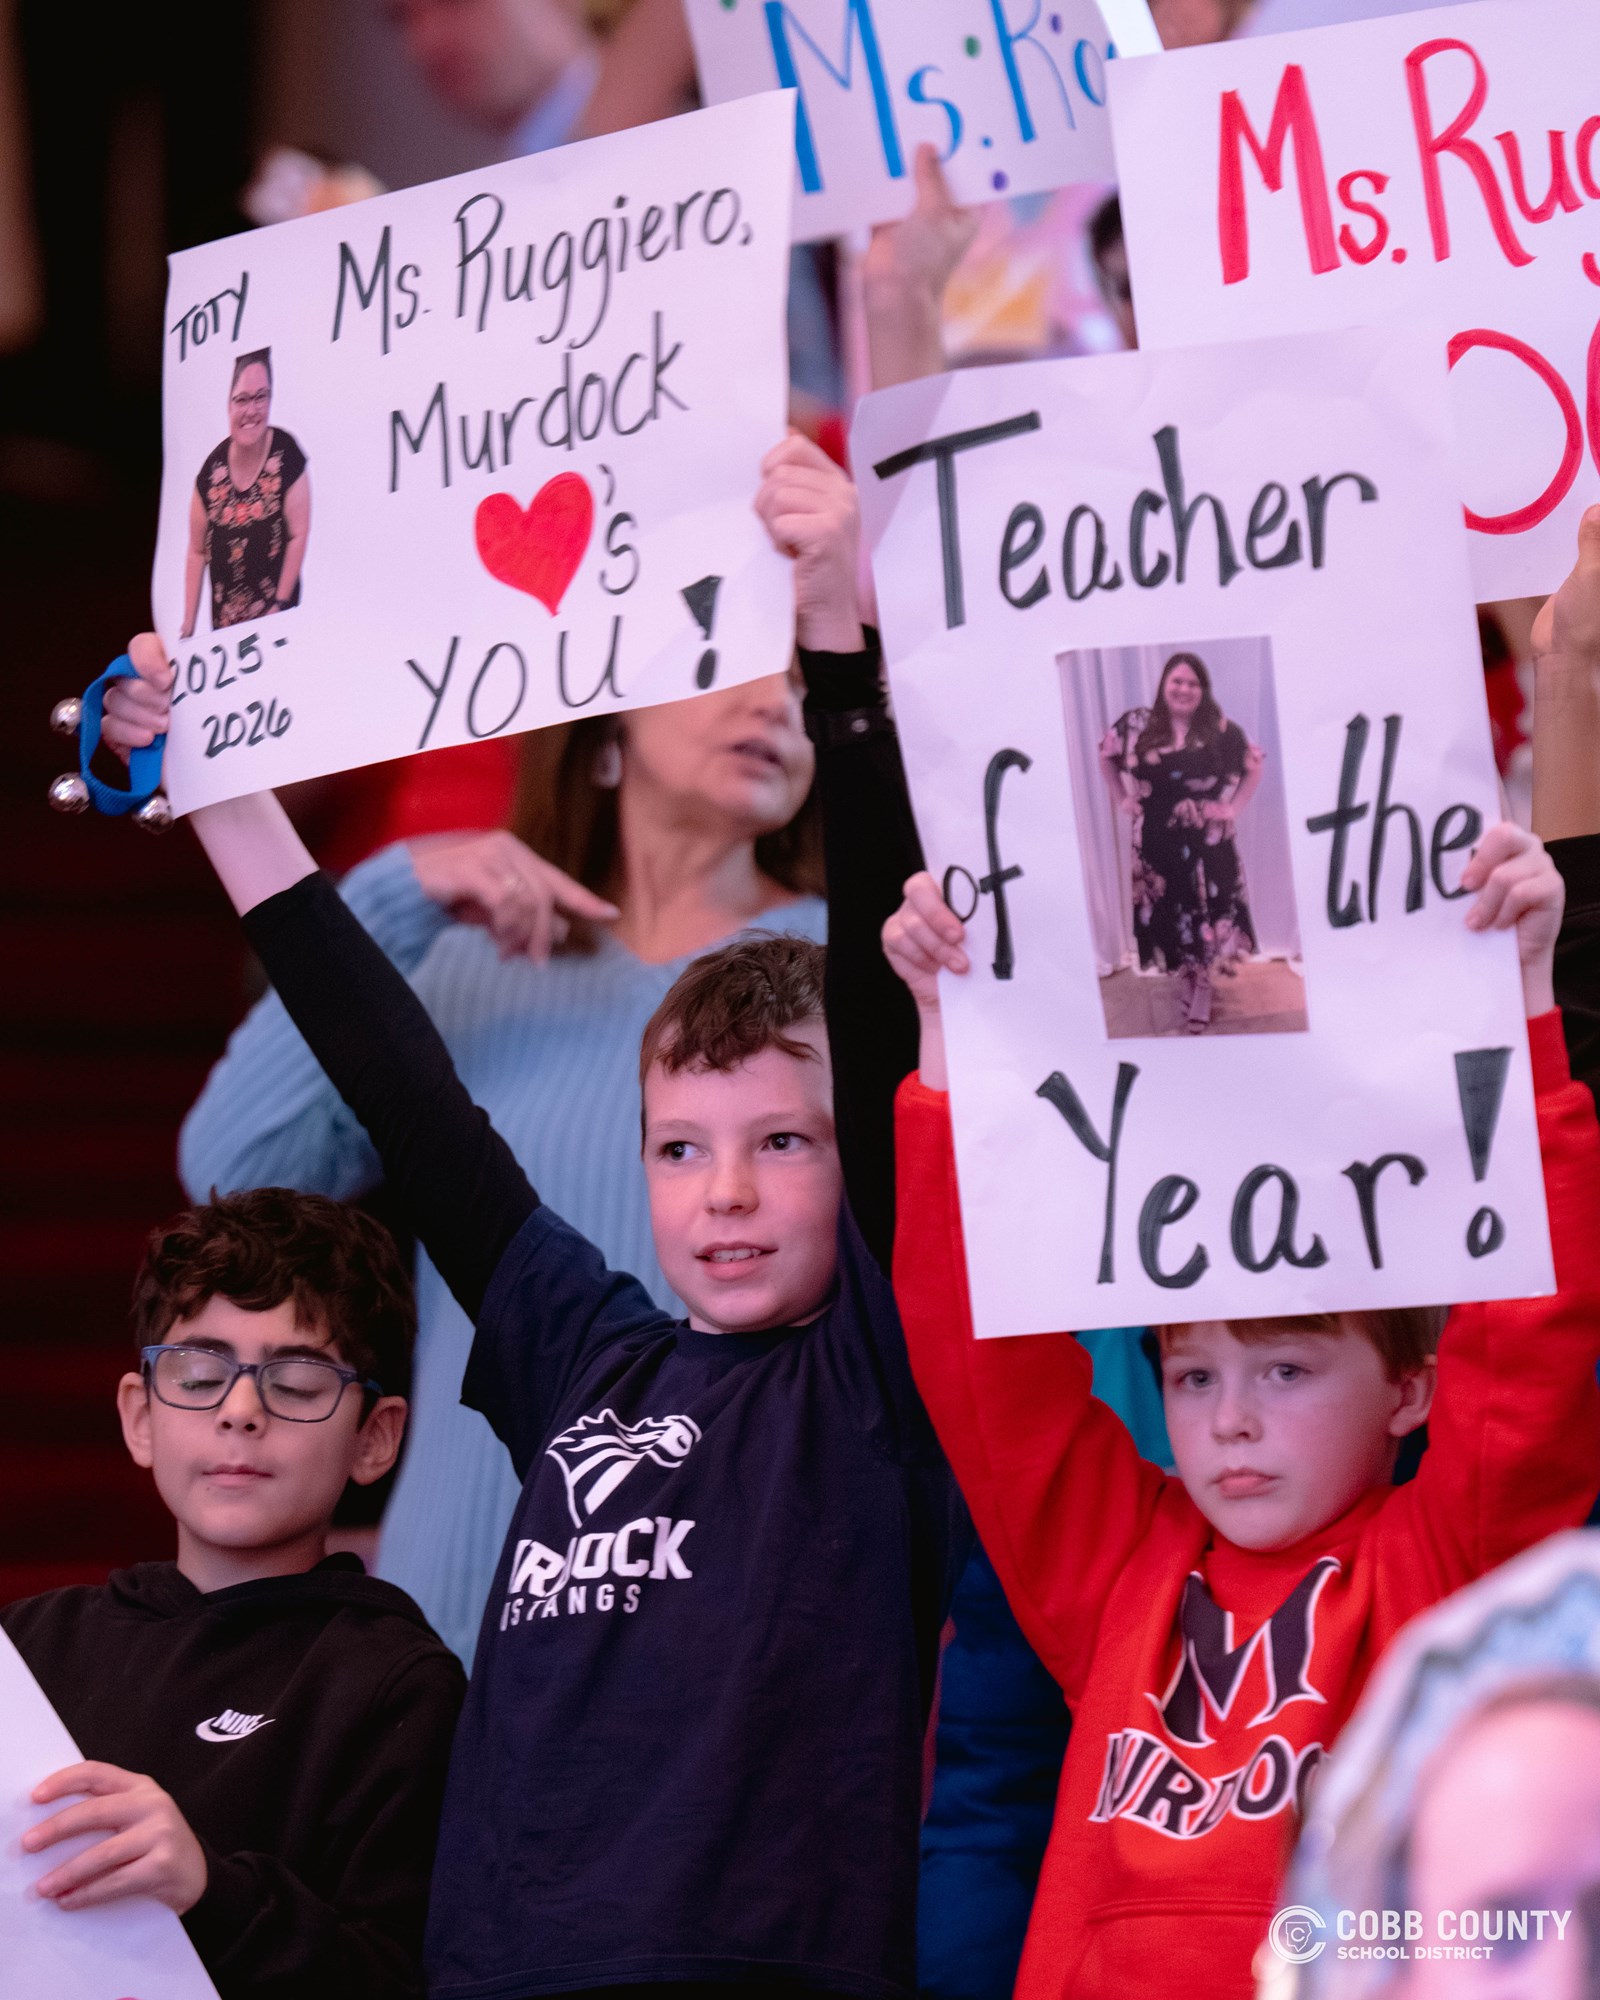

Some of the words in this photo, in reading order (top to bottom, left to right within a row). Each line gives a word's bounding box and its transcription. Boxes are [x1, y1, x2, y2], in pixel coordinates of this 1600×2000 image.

[764, 0, 993, 194] Ms.
[991, 0, 1118, 143] Ro
[1218, 63, 1407, 286] Ms.
[170, 270, 249, 363] TOTY
[331, 226, 432, 354] Ms.
[454, 187, 754, 350] Ruggiero,
[388, 311, 689, 493] Murdock
[873, 410, 1379, 630] Teacher
[202, 697, 292, 759] 2026
[943, 748, 1032, 980] of
[1306, 713, 1482, 929] the
[500, 1583, 642, 1632] STANGS
[508, 1515, 696, 1598] ROCK
[211, 1708, 265, 1735] NIKE
